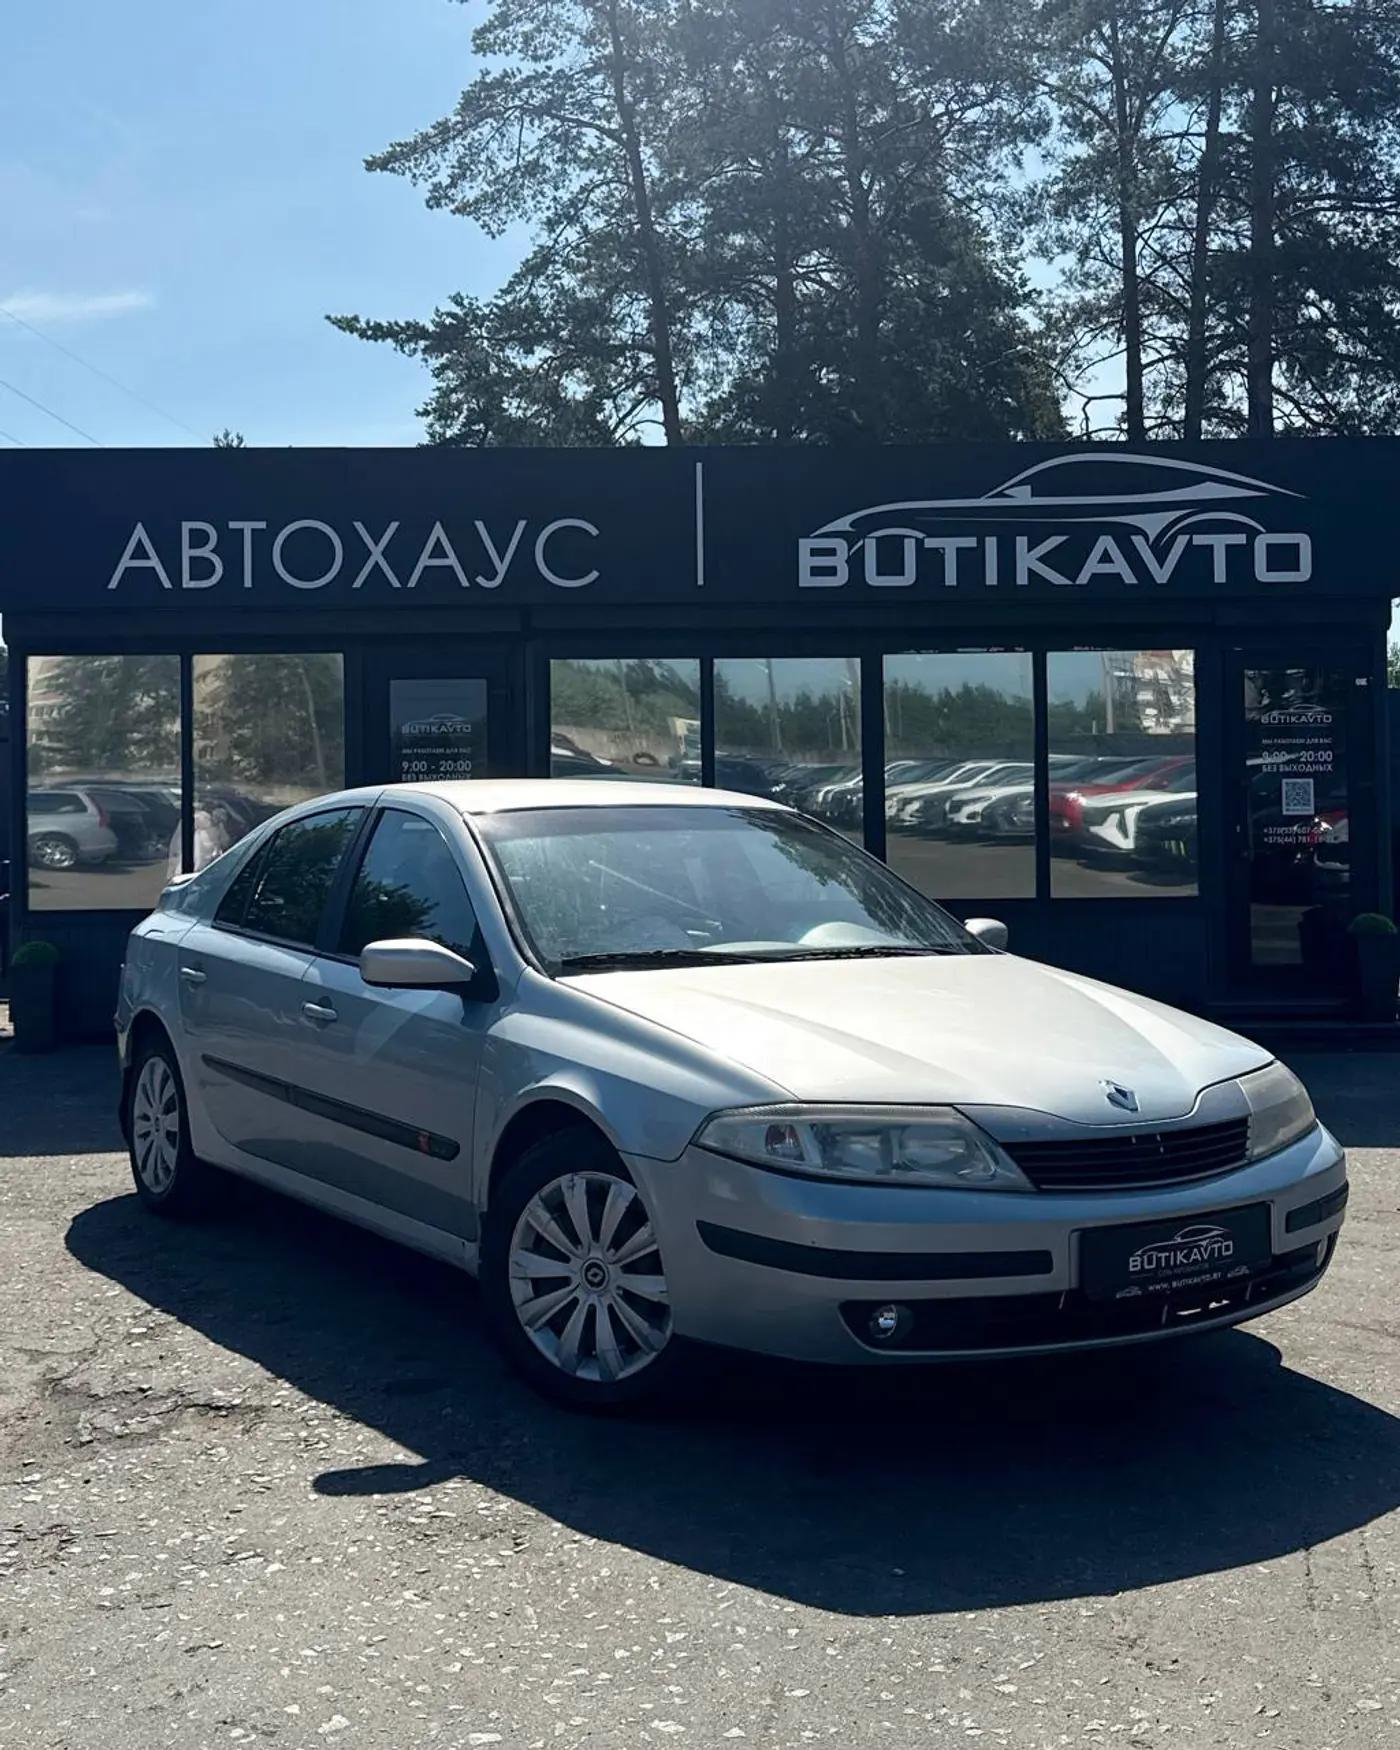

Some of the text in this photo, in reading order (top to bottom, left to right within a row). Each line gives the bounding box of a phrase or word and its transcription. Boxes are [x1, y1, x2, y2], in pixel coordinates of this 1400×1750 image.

[107, 518, 601, 590] АВТОХАУС
[798, 533, 1312, 588] BUTIKAVTO
[1261, 714, 1332, 724] BUTIKAVTO
[402, 724, 472, 734] BUTIKAVTO
[1300, 750, 1334, 762] 20:00
[402, 761, 428, 773] 9:00
[440, 760, 472, 772] 20:00
[1262, 764, 1333, 773] БЕЗ ВЫХОДНЫХ
[1129, 1241, 1233, 1271] BUTIKAVTO
